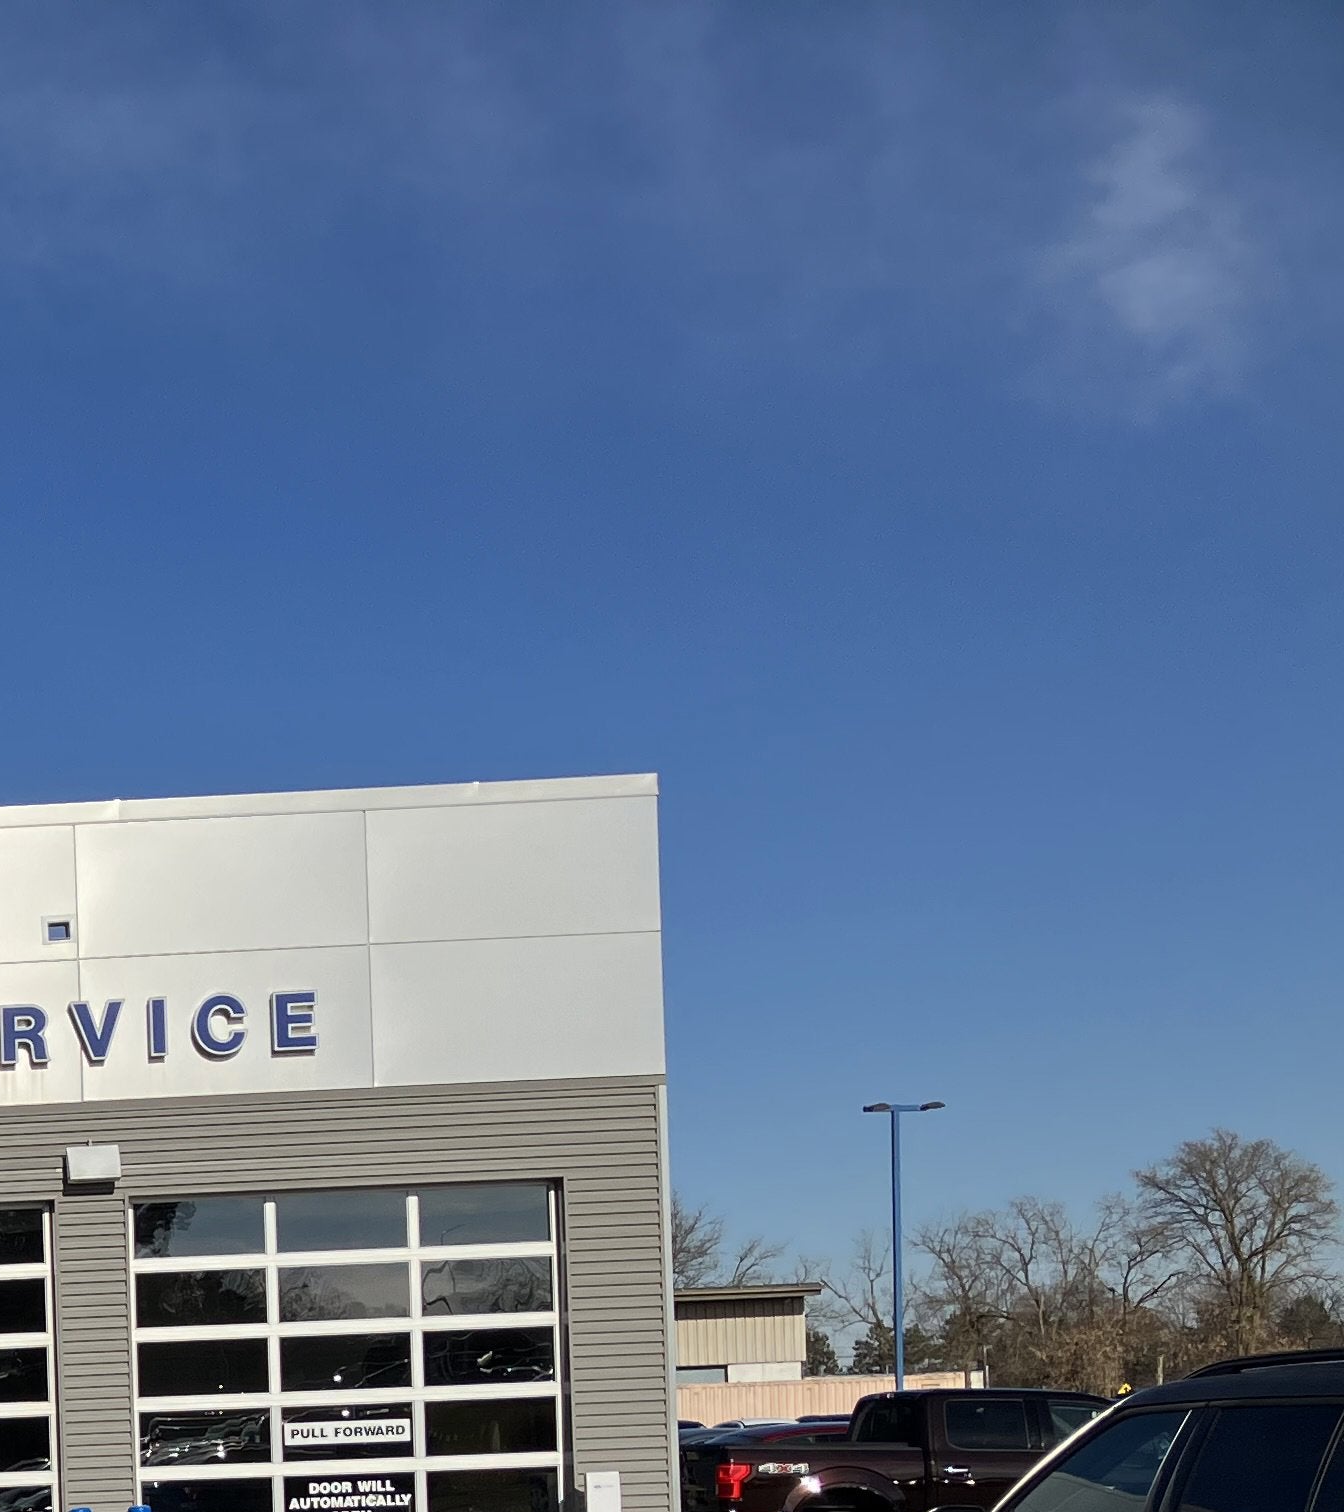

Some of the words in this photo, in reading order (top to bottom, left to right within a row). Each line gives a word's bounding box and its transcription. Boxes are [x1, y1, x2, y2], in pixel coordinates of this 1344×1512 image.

[291, 1427, 328, 1439] PULL
[334, 1425, 406, 1438] FORWARD
[308, 1481, 353, 1495] DOOR
[357, 1480, 395, 1493] WILL
[288, 1493, 412, 1510] AUTOMATICALLY
